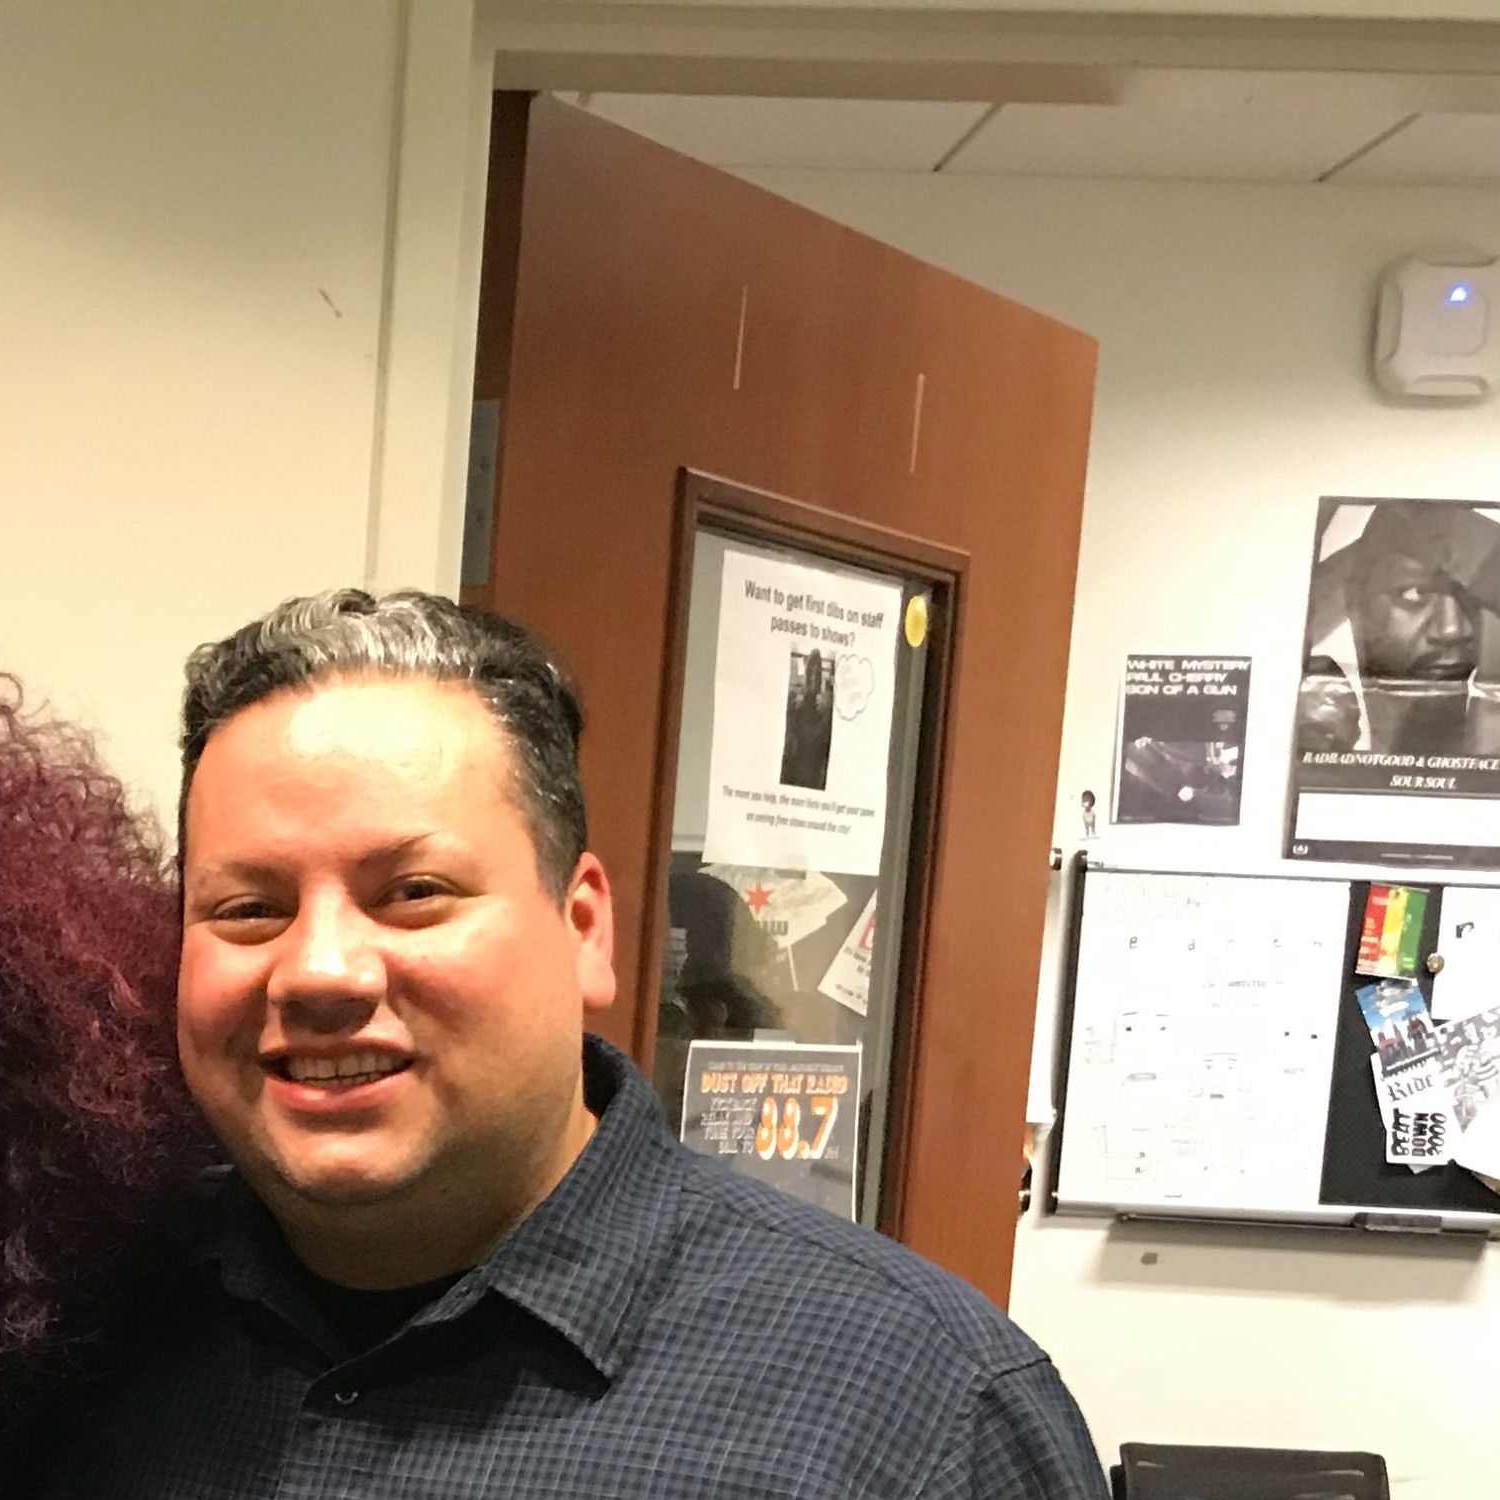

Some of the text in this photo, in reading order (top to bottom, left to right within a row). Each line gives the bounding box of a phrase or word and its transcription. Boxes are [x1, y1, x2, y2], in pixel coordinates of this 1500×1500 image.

[744, 579, 884, 629] Want to get first dibs on staff
[770, 616, 856, 647] passes to shows?
[1127, 659, 1252, 671] WHITE MYSTERY
[1125, 684, 1237, 695] SON OF A GUN
[701, 1071, 849, 1095] DUST OFF THAT RADIO
[755, 1095, 839, 1161] 88.7
[1411, 1112, 1429, 1157] DOWN
